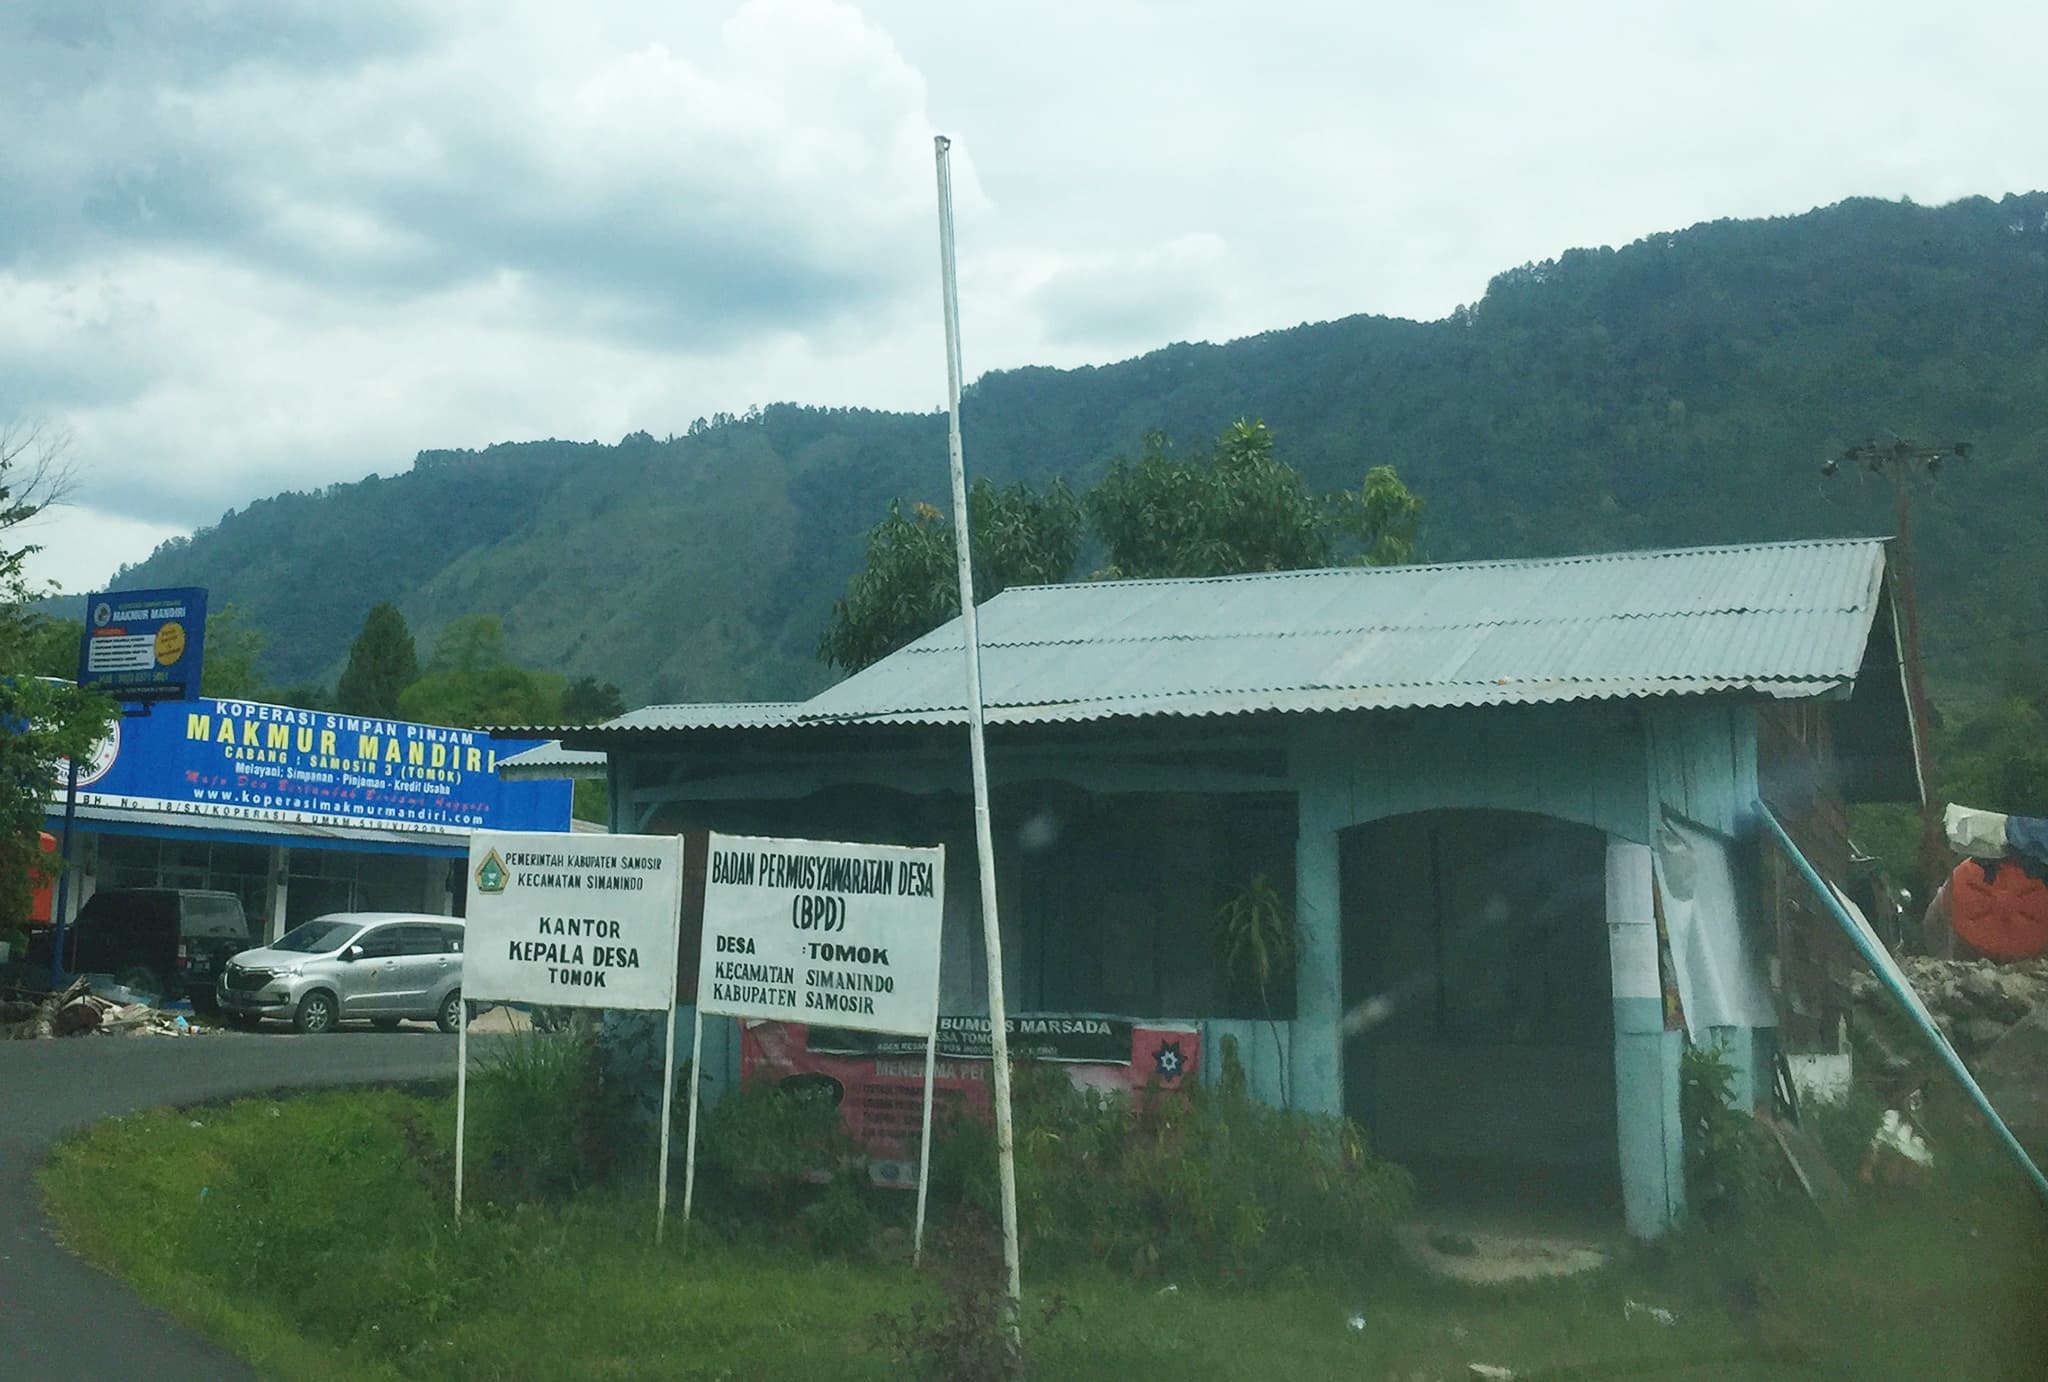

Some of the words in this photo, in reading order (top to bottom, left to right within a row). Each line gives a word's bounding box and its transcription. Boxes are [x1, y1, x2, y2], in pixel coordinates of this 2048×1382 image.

[113, 609, 149, 622] MAKMUR
[150, 606, 186, 619] MANDIRI
[216, 701, 316, 726] KOPERASI
[327, 715, 397, 737] SIMPAN
[407, 726, 473, 745] PINJAM
[187, 713, 336, 756] MAKMUR
[358, 733, 496, 774] MANDIRI
[224, 746, 288, 764] CABANG
[309, 755, 377, 775] SAMOSIR
[384, 763, 393, 776] 3
[401, 766, 463, 785] (TOMOK)
[287, 768, 334, 785] Simpanan
[343, 773, 386, 789] Pinjaman
[394, 780, 422, 793] Kredit
[423, 784, 451, 796] Usaha
[193, 788, 483, 825] www.koperasimakmurmandiri.com
[505, 852, 564, 867] PEMERINTAH
[567, 855, 617, 869] KABUPATEN
[621, 856, 662, 870] SAMOSIR
[712, 851, 754, 886] BADAN
[759, 853, 894, 896] PERMUSYAWARATAN
[898, 860, 935, 898] DESA
[517, 873, 581, 889] KECAMATAN
[587, 875, 644, 891] SIMANINDO
[792, 894, 846, 932] (BPD)
[539, 916, 621, 939] KANTOR
[509, 940, 584, 965] KEPALA
[592, 946, 640, 968] DESA
[716, 935, 756, 955] DESA
[548, 967, 607, 987] TOMOK
[715, 961, 794, 985] KECAMATAN
[806, 969, 894, 993] SIMANINDO
[713, 983, 797, 1007] KABUPATEN
[805, 991, 875, 1015] SAMOSIR
[940, 1017, 1014, 1033] BUMDS
[1020, 1020, 1113, 1036] MARSADA
